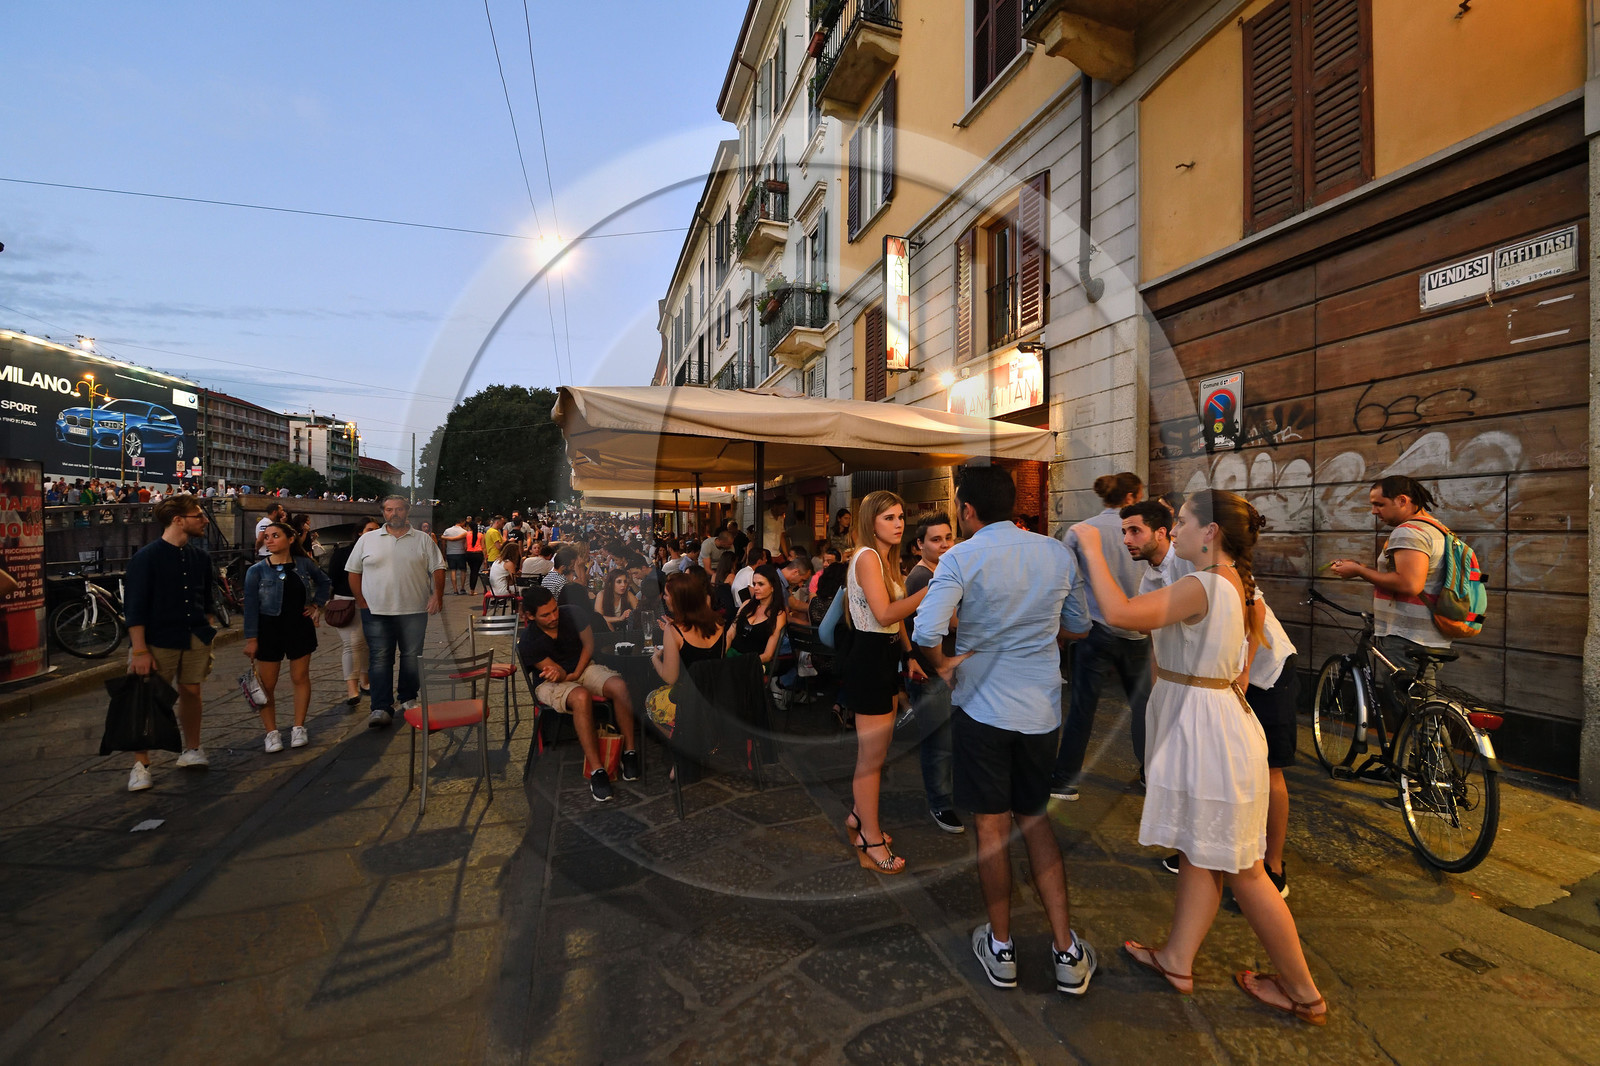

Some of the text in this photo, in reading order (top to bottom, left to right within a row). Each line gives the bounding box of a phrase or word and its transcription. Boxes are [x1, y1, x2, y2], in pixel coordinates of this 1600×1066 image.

[1500, 233, 1572, 267] AFFITTASI
[1429, 257, 1487, 289] VENDESI
[1202, 381, 1219, 390] Comune
[1, 399, 38, 414] SPORT.
[14, 590, 26, 599] PM
